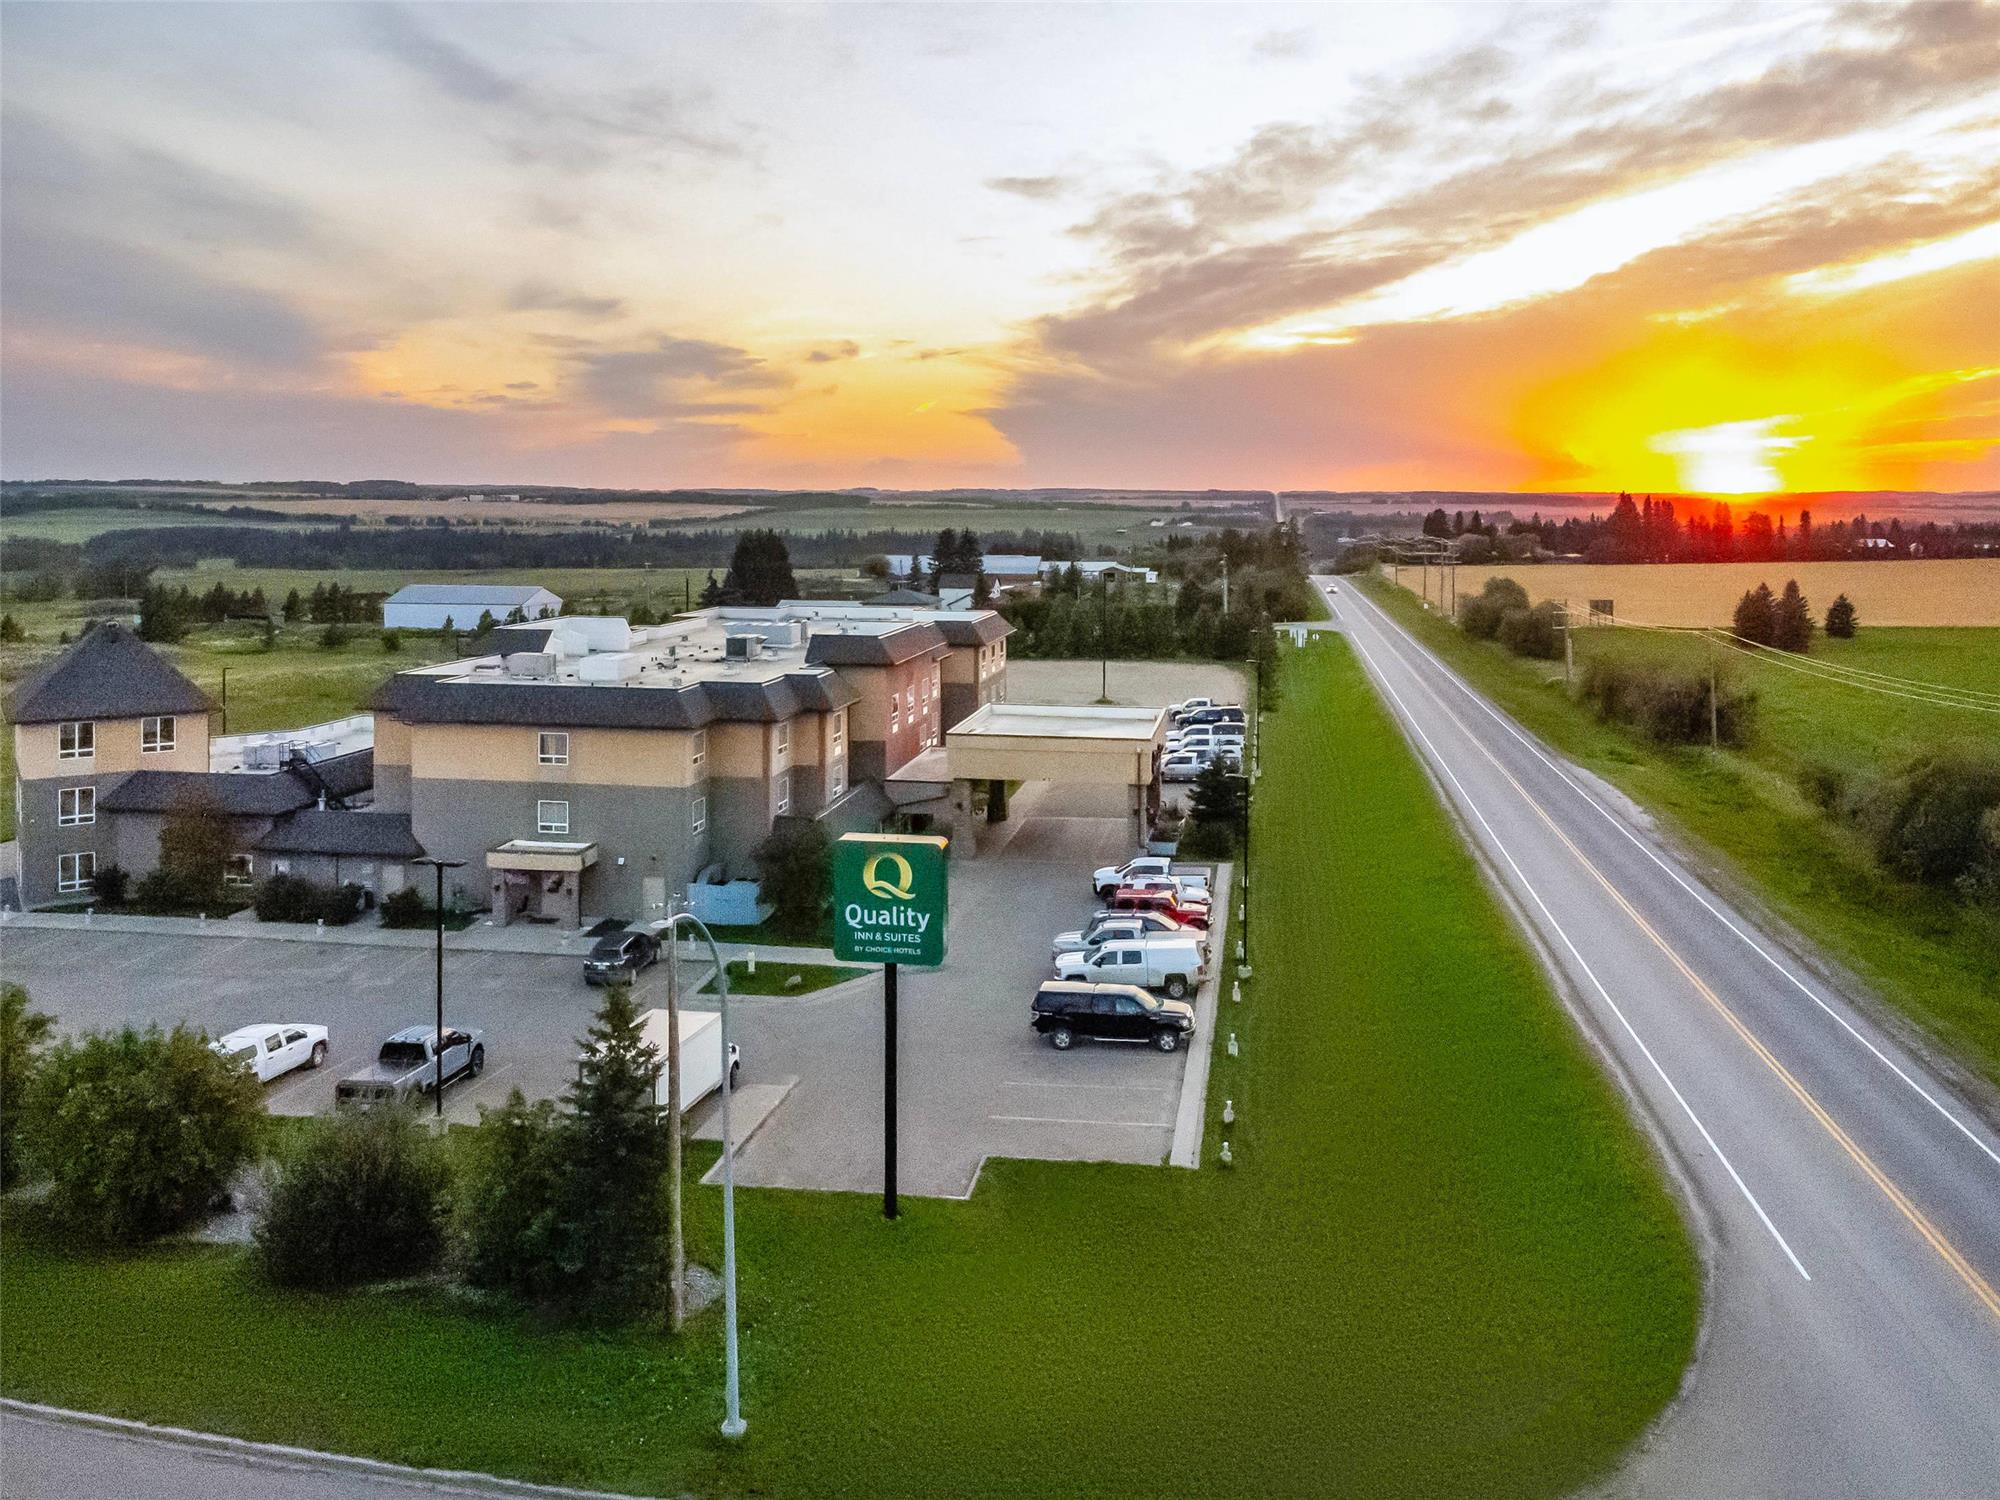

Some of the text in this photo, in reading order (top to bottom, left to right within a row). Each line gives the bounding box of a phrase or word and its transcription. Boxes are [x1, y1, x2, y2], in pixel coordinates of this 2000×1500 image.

[863, 852, 916, 900] Q
[845, 904, 930, 932] Quality
[854, 931, 921, 943] INN & SUITES
[894, 947, 921, 955] HOTELS
